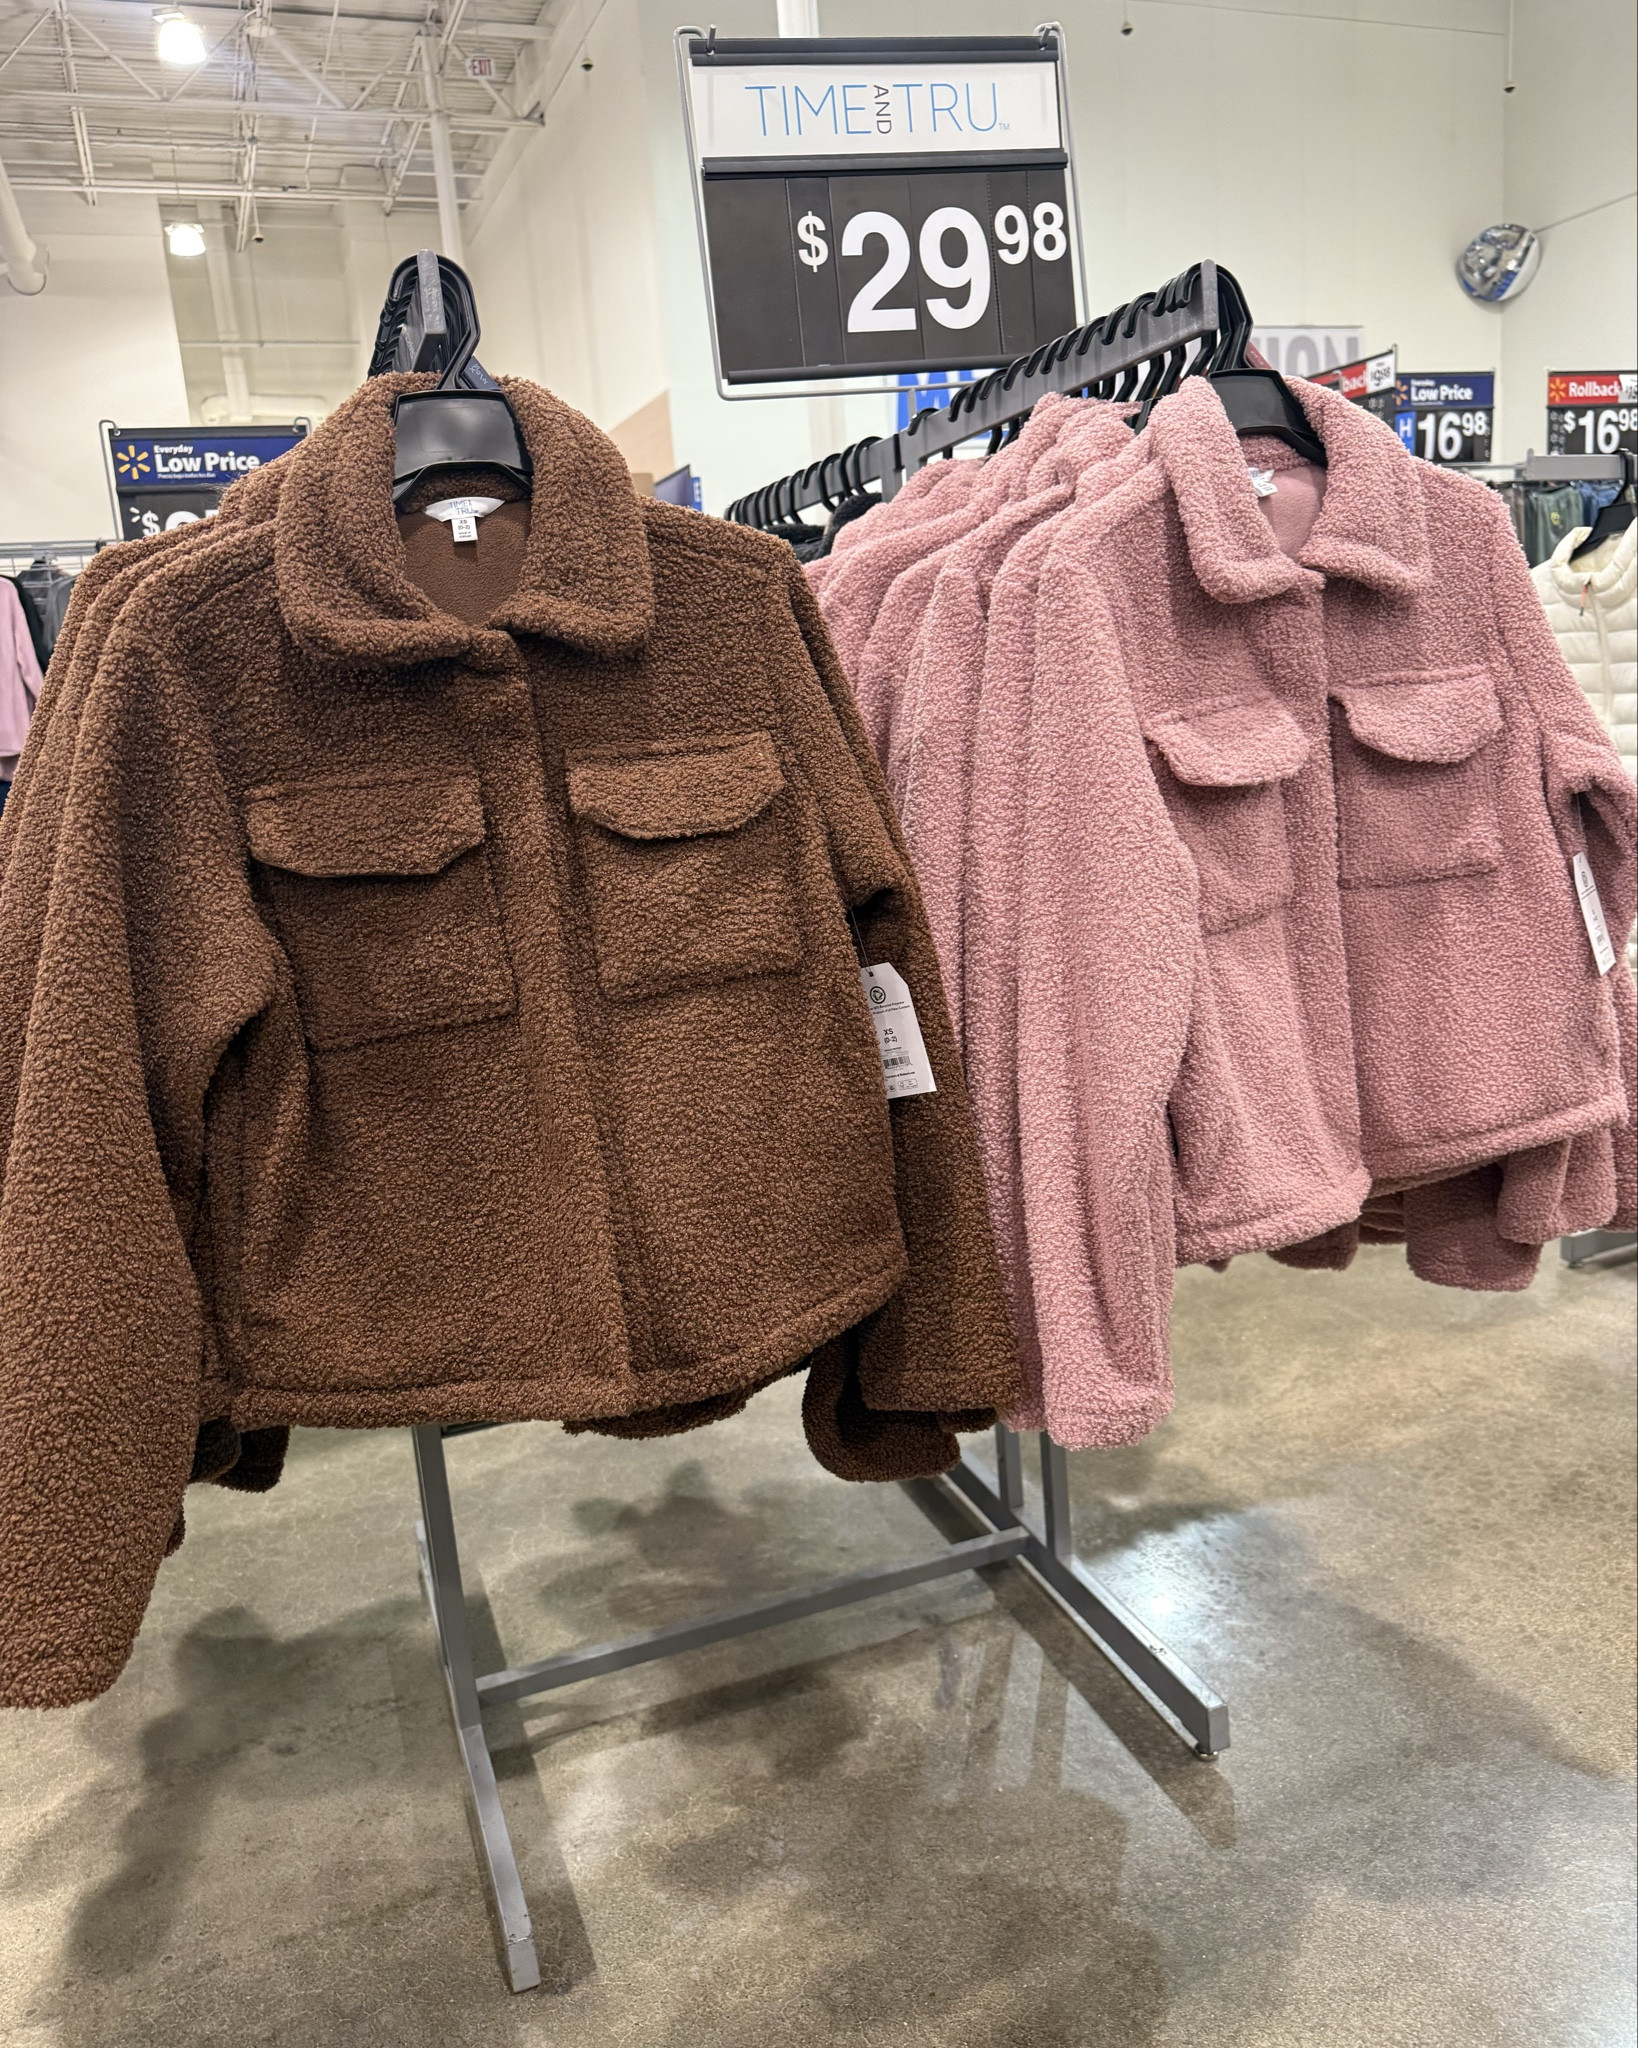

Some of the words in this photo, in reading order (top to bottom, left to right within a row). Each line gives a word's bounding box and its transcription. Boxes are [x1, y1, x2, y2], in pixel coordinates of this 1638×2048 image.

[744, 84, 872, 136] TIME
[873, 85, 892, 135] AND
[893, 82, 998, 133] TRU
[1410, 386, 1439, 401] Low
[1440, 384, 1473, 400] Price
[1569, 381, 1621, 397] Rollback
[154, 444, 193, 454] Everyday
[154, 453, 202, 473] Low
[204, 451, 260, 471] Price
[448, 500, 469, 509] TIME
[883, 1028, 893, 1036] XS
[884, 1036, 897, 1044] (0-2)
